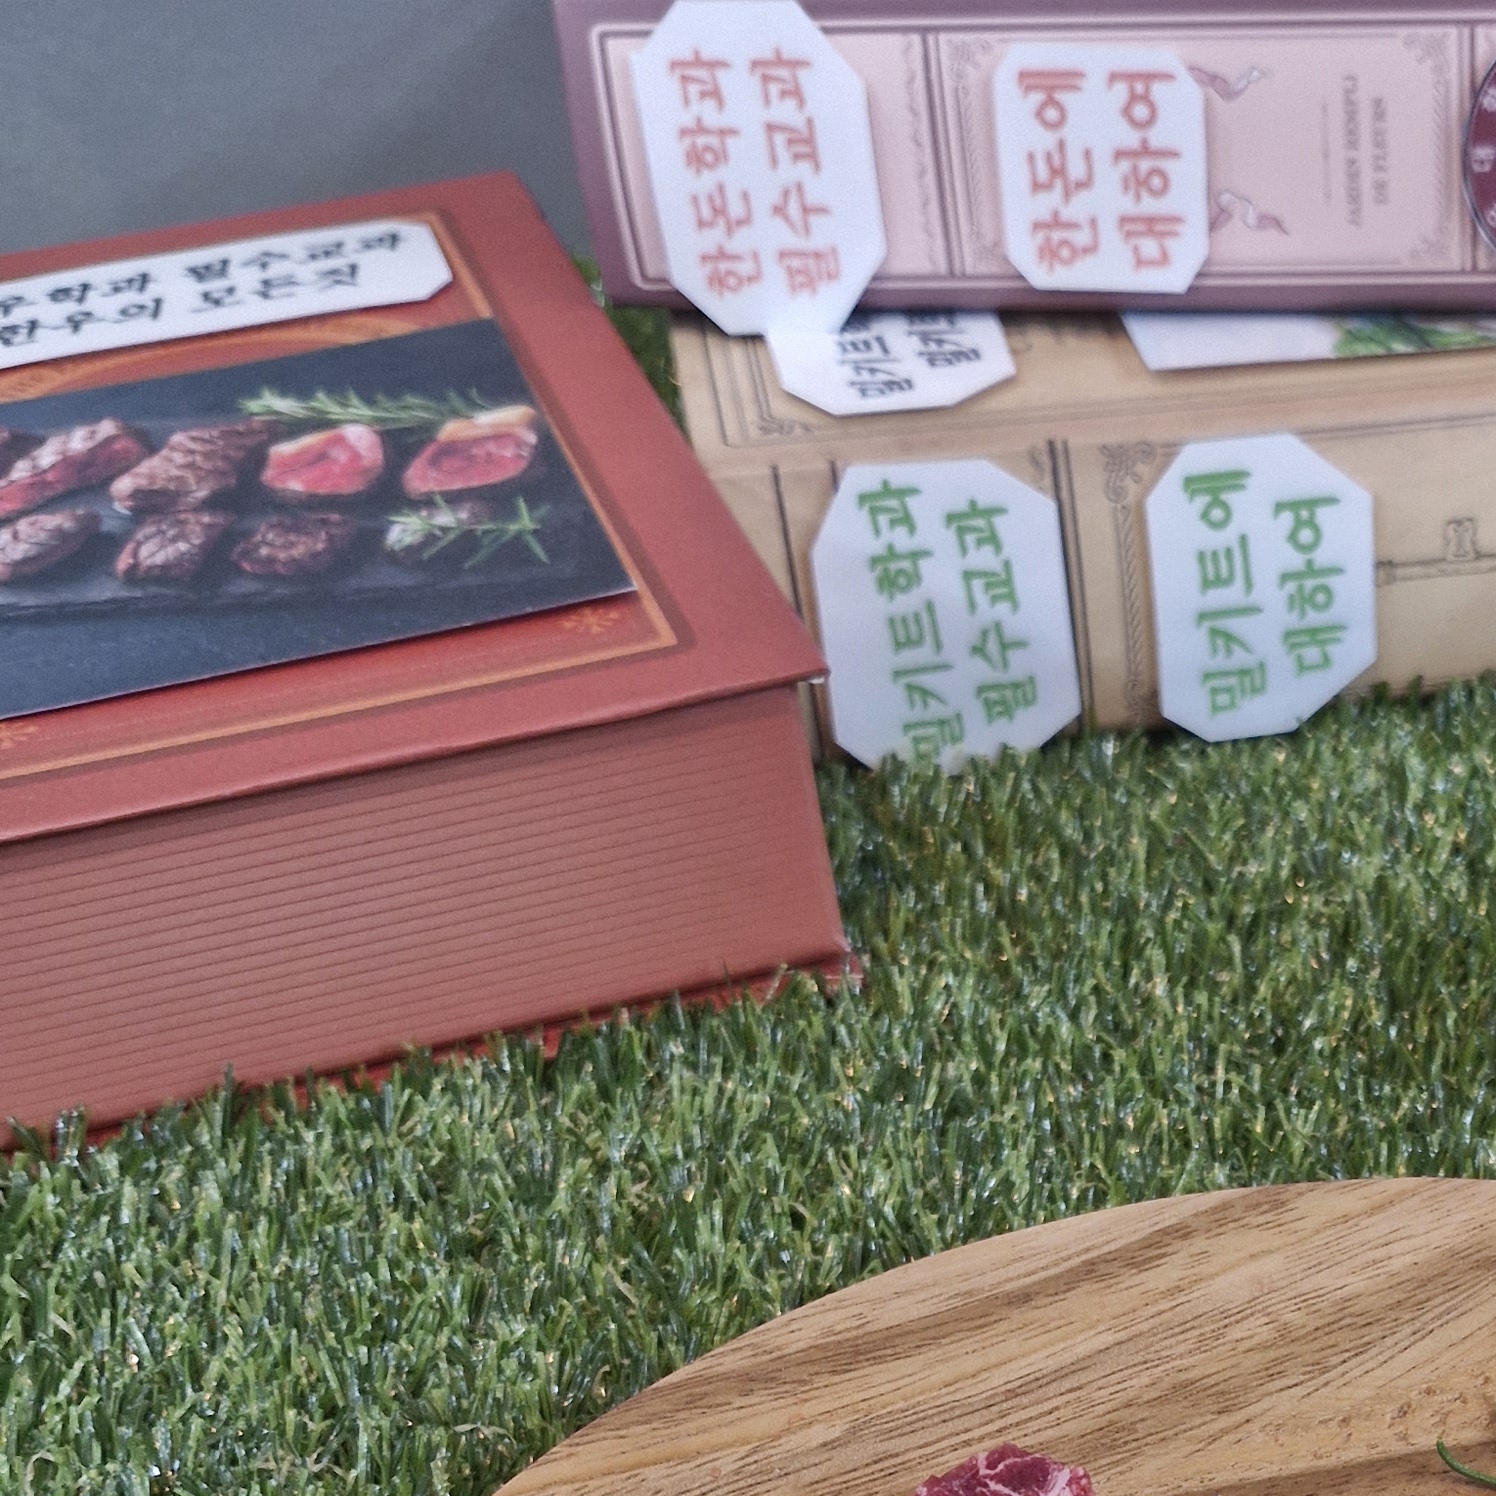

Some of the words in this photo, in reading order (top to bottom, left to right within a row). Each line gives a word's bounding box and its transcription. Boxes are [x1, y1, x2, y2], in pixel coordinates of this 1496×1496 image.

[669, 49, 763, 297] 한돈학과
[749, 45, 840, 296] 필수교과
[1017, 69, 1099, 275] 한돈에
[1108, 70, 1186, 272] 대하여
[857, 479, 965, 763] 밀키트학과
[945, 498, 1037, 725] 필수교과
[1183, 470, 1269, 718] 밀키트에
[1275, 496, 1348, 678] 대하여
